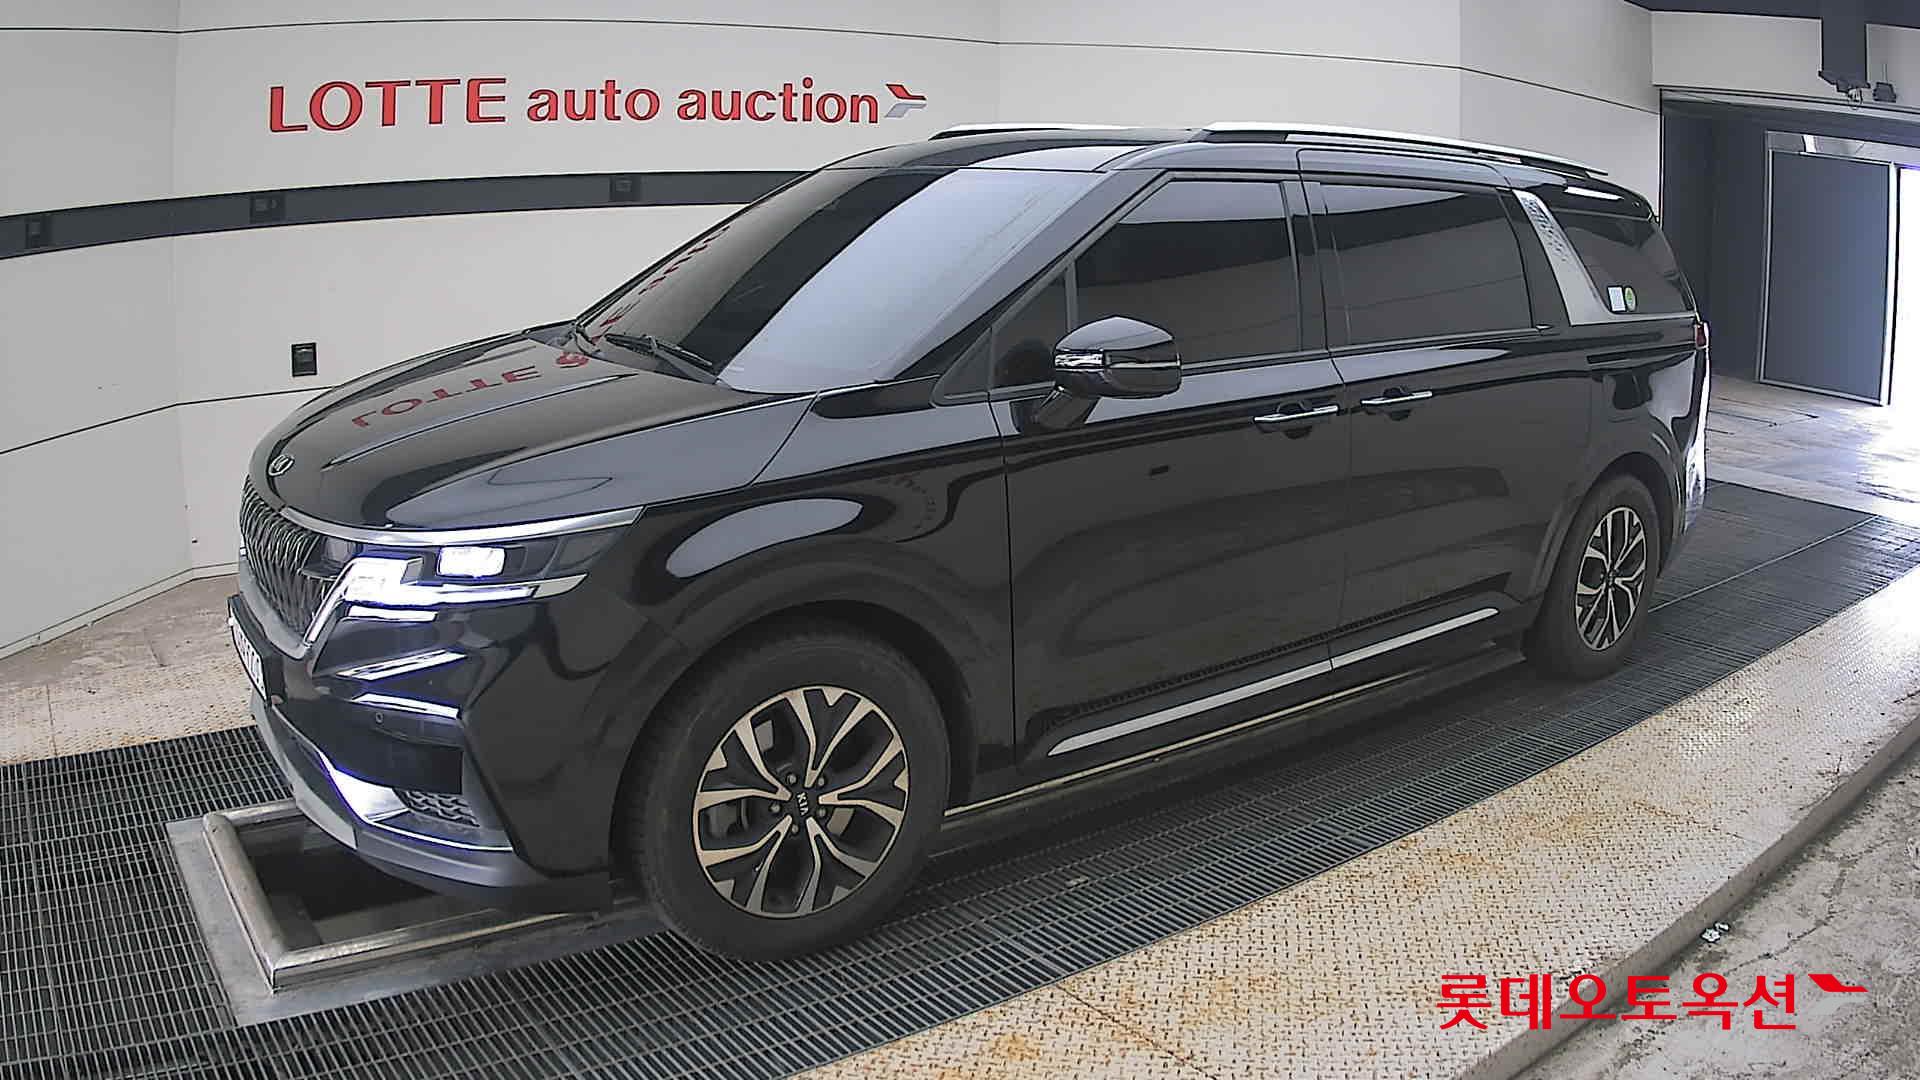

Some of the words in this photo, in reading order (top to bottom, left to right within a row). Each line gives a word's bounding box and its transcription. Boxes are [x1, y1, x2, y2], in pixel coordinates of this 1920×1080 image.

[269, 77, 507, 134] LOTTE
[526, 78, 662, 123] auto
[676, 76, 880, 124] auction
[796, 791, 809, 816] KIA
